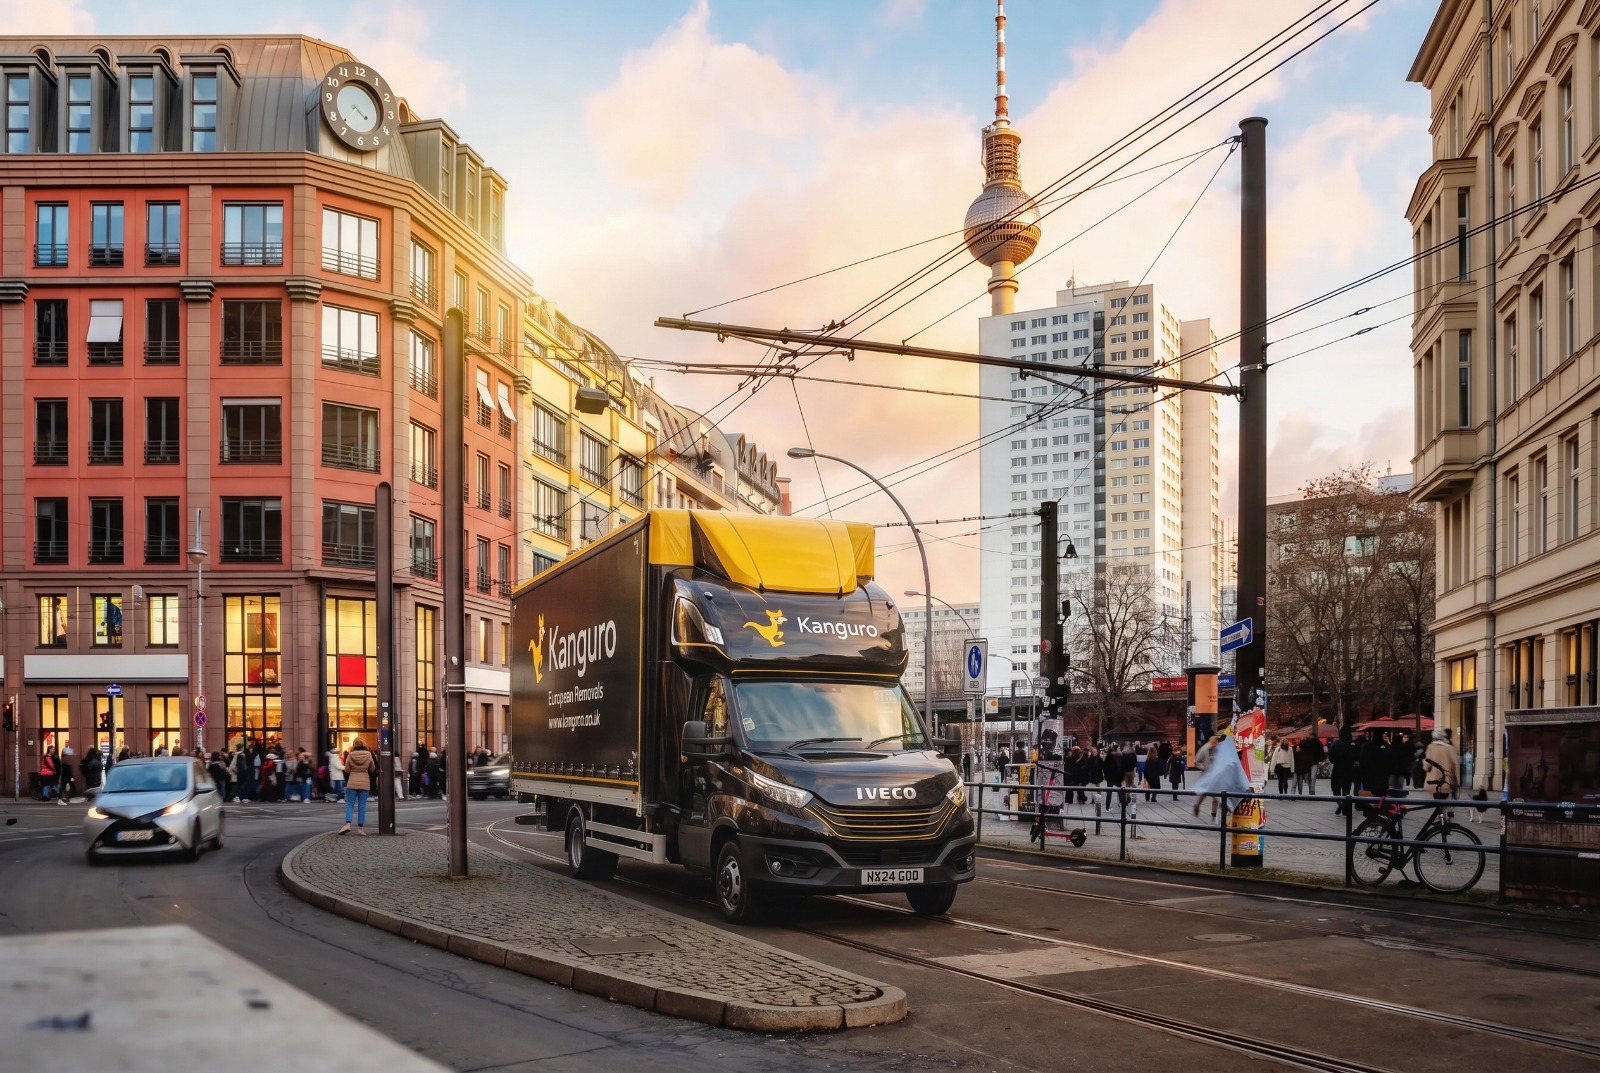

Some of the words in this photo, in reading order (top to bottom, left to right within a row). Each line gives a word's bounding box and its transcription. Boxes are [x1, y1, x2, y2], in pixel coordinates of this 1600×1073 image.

[338, 66, 348, 77] 11
[354, 66, 366, 77] 12
[327, 77, 339, 87] 10
[374, 78, 379, 86] 1
[326, 93, 332, 102] 9
[384, 93, 390, 102] 2
[330, 112, 337, 121] 8
[388, 111, 394, 119] 3
[341, 127, 347, 135] 7
[383, 126, 389, 135] 4
[357, 137, 364, 145] 6
[373, 137, 379, 145] 5
[797, 617, 878, 640] Kanguro
[549, 620, 616, 677] Kanguro
[549, 691, 573, 708] European
[575, 681, 603, 702] Removals
[856, 787, 916, 800] IVECO
[867, 871, 895, 882] NX24
